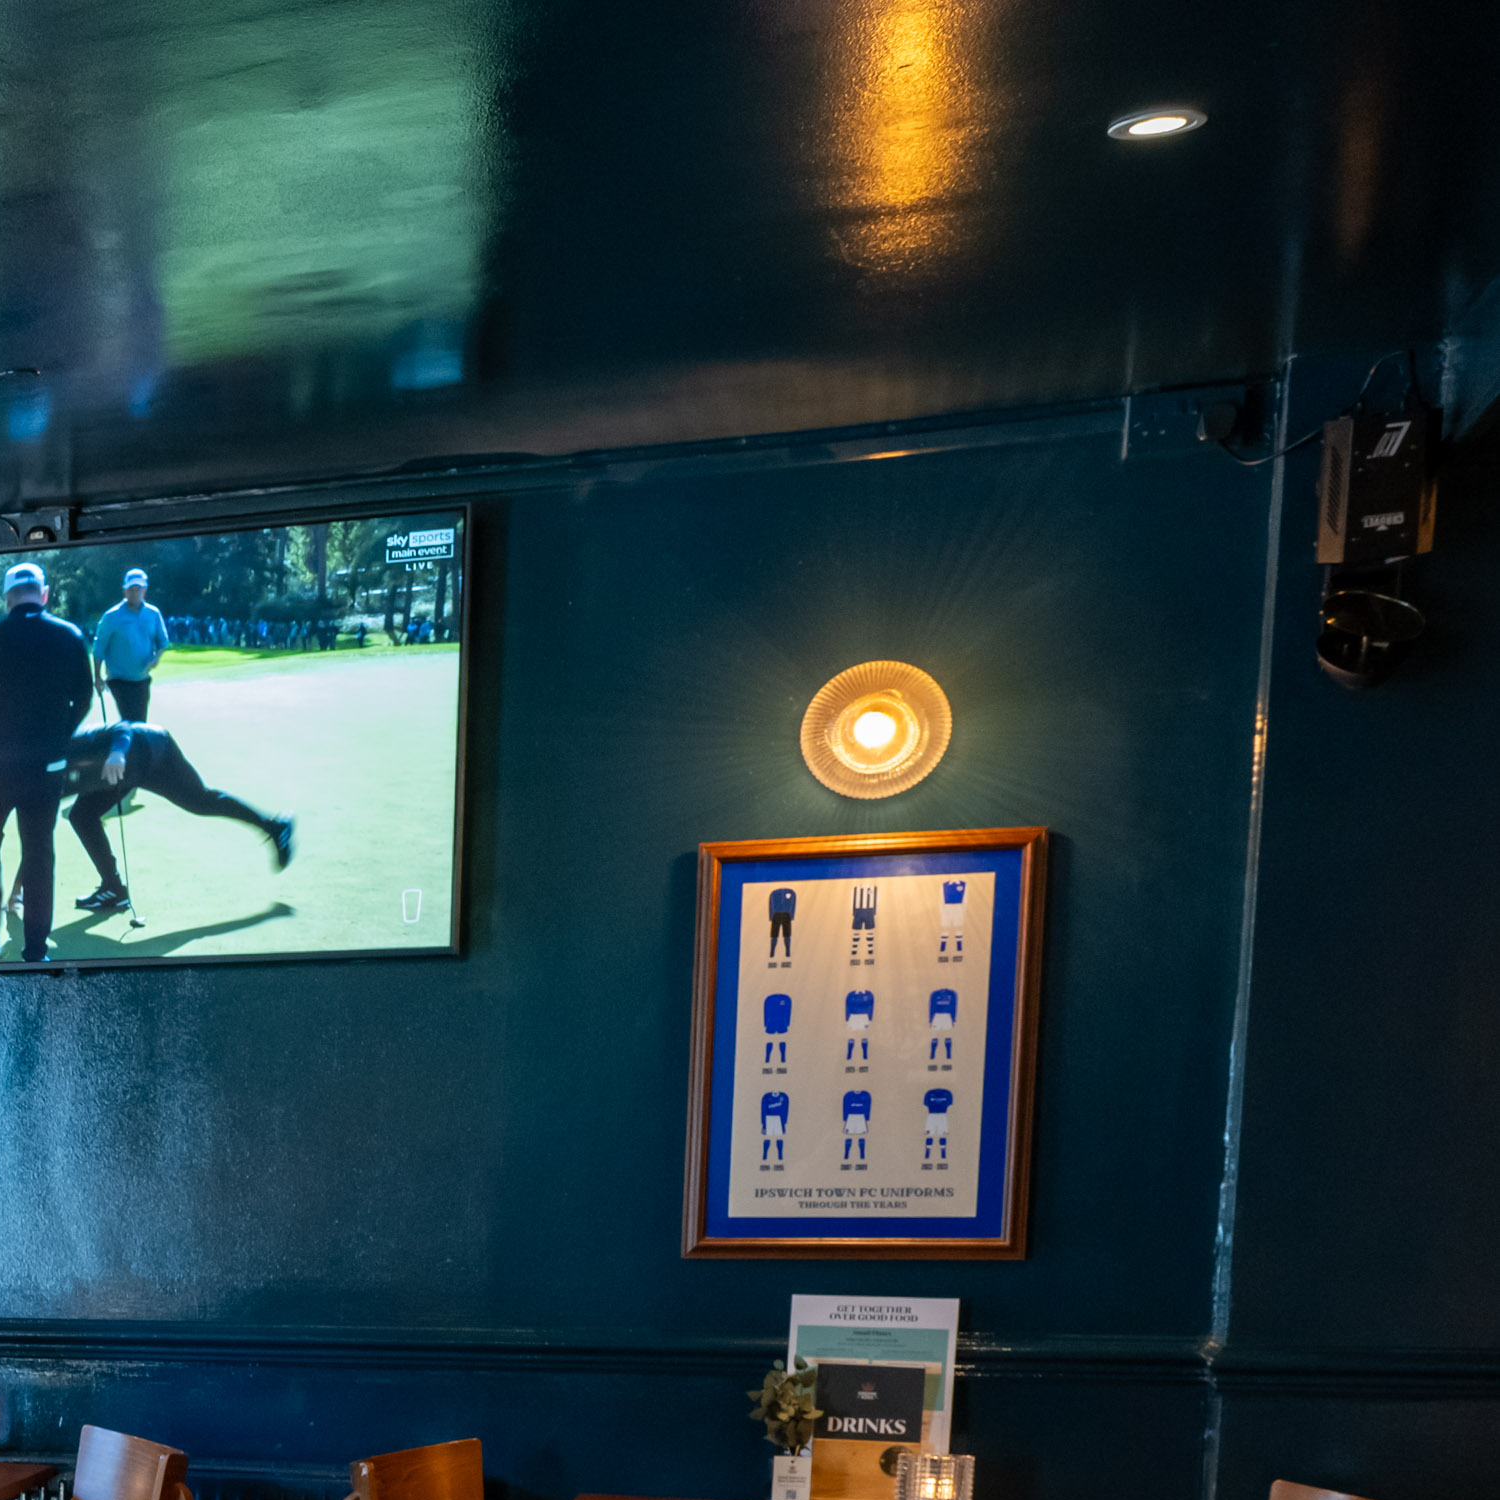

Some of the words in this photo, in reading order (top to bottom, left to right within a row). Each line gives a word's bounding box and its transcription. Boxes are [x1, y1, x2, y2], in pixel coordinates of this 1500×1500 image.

[387, 534, 408, 548] sky
[412, 531, 451, 544] sports
[391, 548, 417, 558] main
[417, 545, 448, 556] event
[405, 561, 434, 572] LIVE
[754, 1187, 813, 1199] IPSWICH
[815, 1187, 856, 1199] TOWN
[859, 1187, 877, 1198] FC
[880, 1187, 955, 1199] UNIFORMS
[798, 1200, 848, 1209] THROUGH
[849, 1200, 871, 1209] THE
[871, 1200, 908, 1209] YEARS
[836, 1305, 856, 1313] GET
[857, 1305, 912, 1314] TOGETHER
[829, 1313, 856, 1321] OVER
[857, 1313, 888, 1321] GOOD
[889, 1314, 919, 1323] FOOD
[826, 1416, 907, 1435] DRINKS
